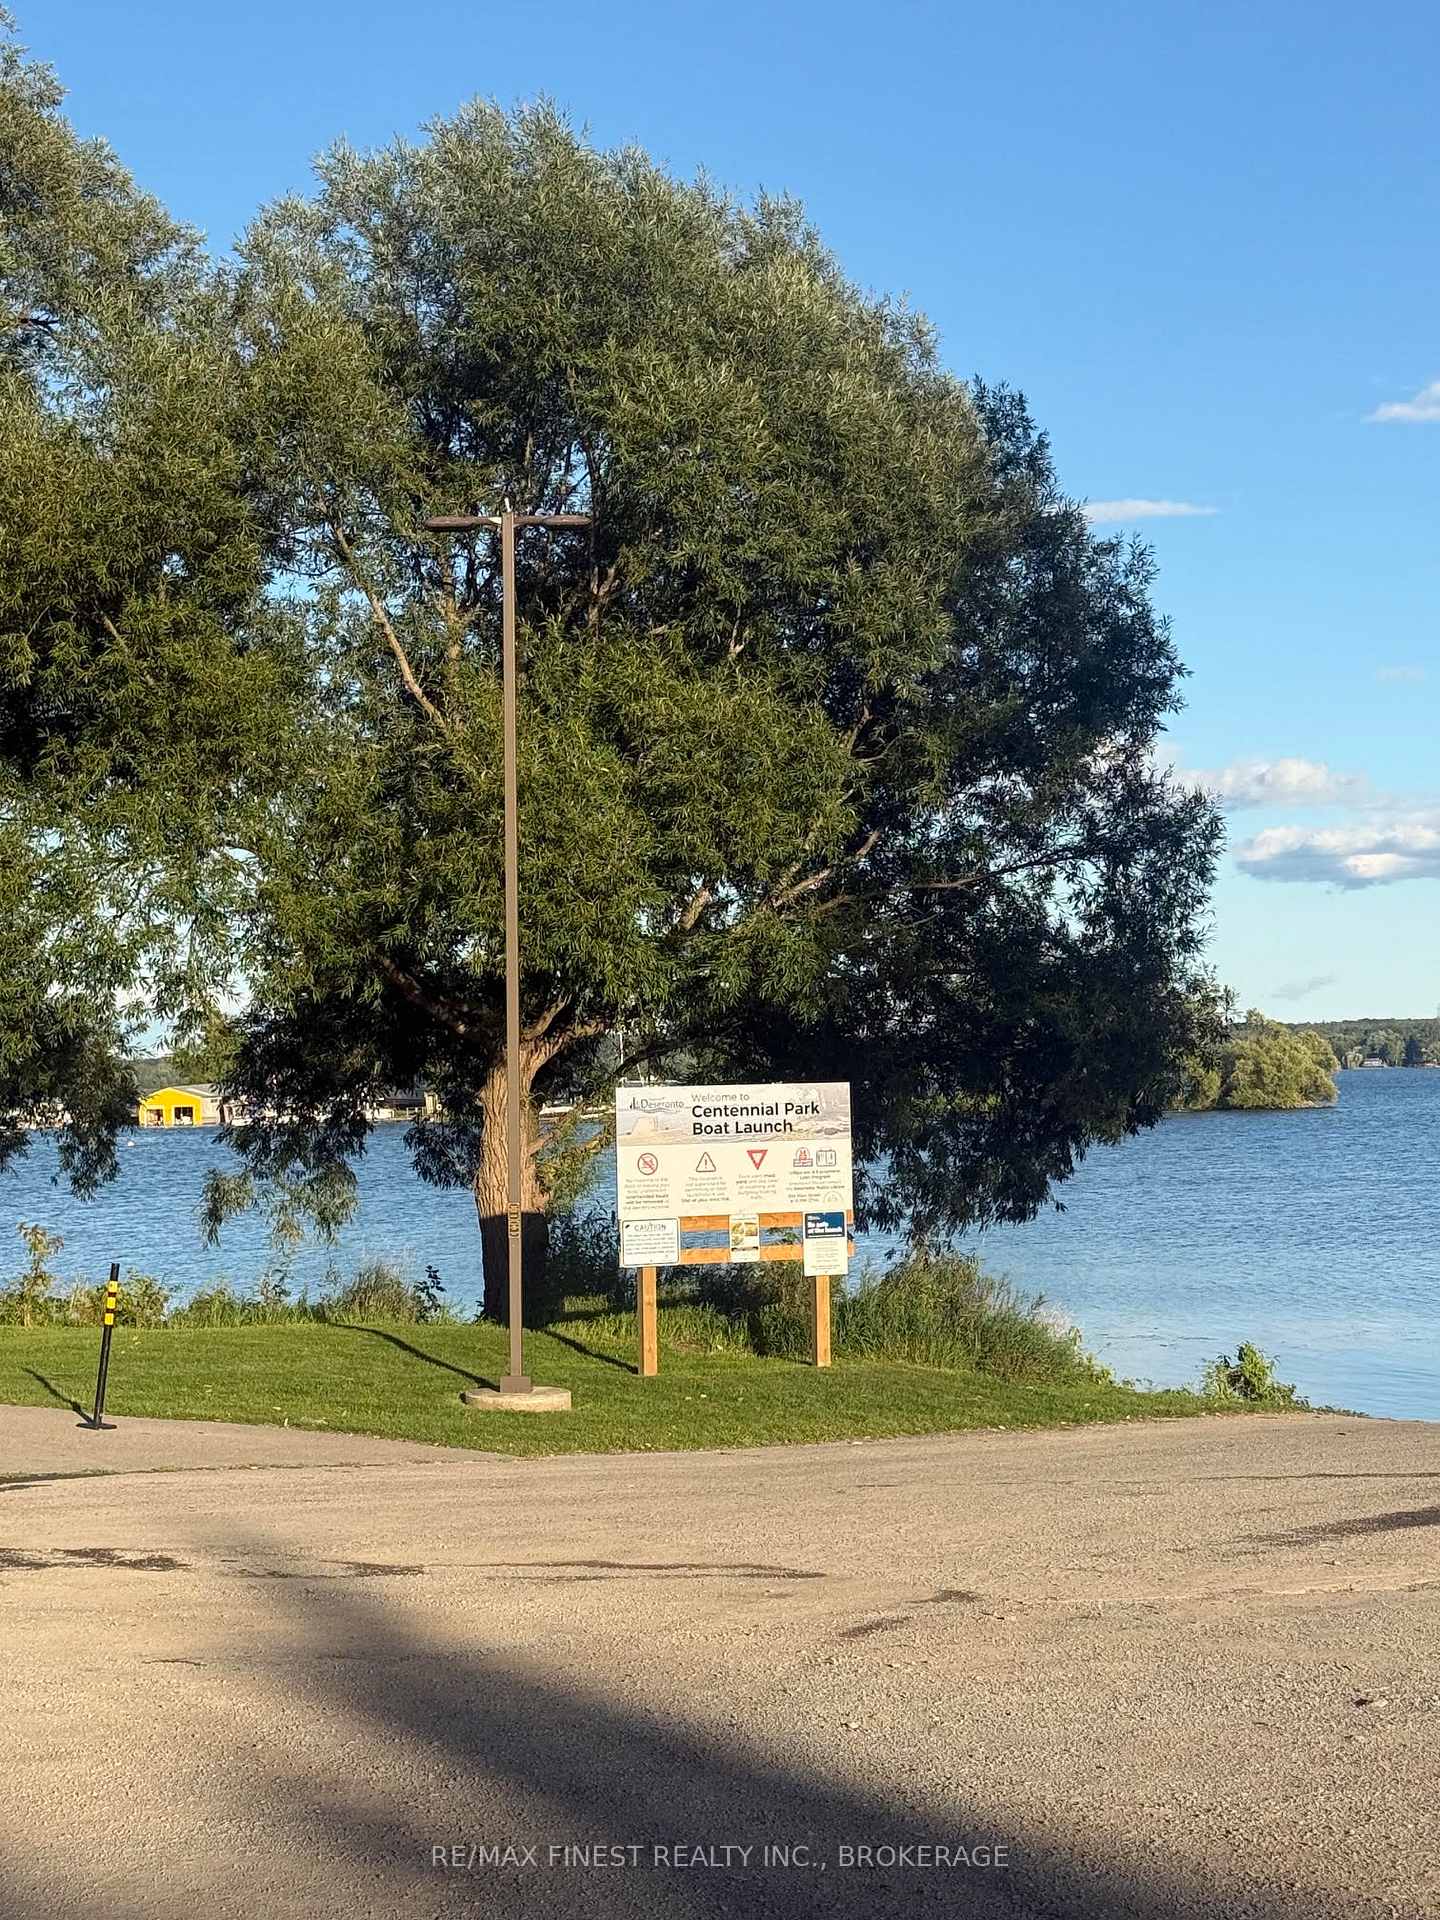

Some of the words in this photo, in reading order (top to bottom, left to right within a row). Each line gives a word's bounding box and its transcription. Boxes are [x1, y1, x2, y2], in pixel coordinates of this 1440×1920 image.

[691, 1093, 737, 1103] Welcome
[739, 1093, 750, 1101] to
[692, 1103, 779, 1118] Centennial
[785, 1102, 820, 1115] Park
[692, 1122, 730, 1135] Boat
[735, 1120, 793, 1134] Launch
